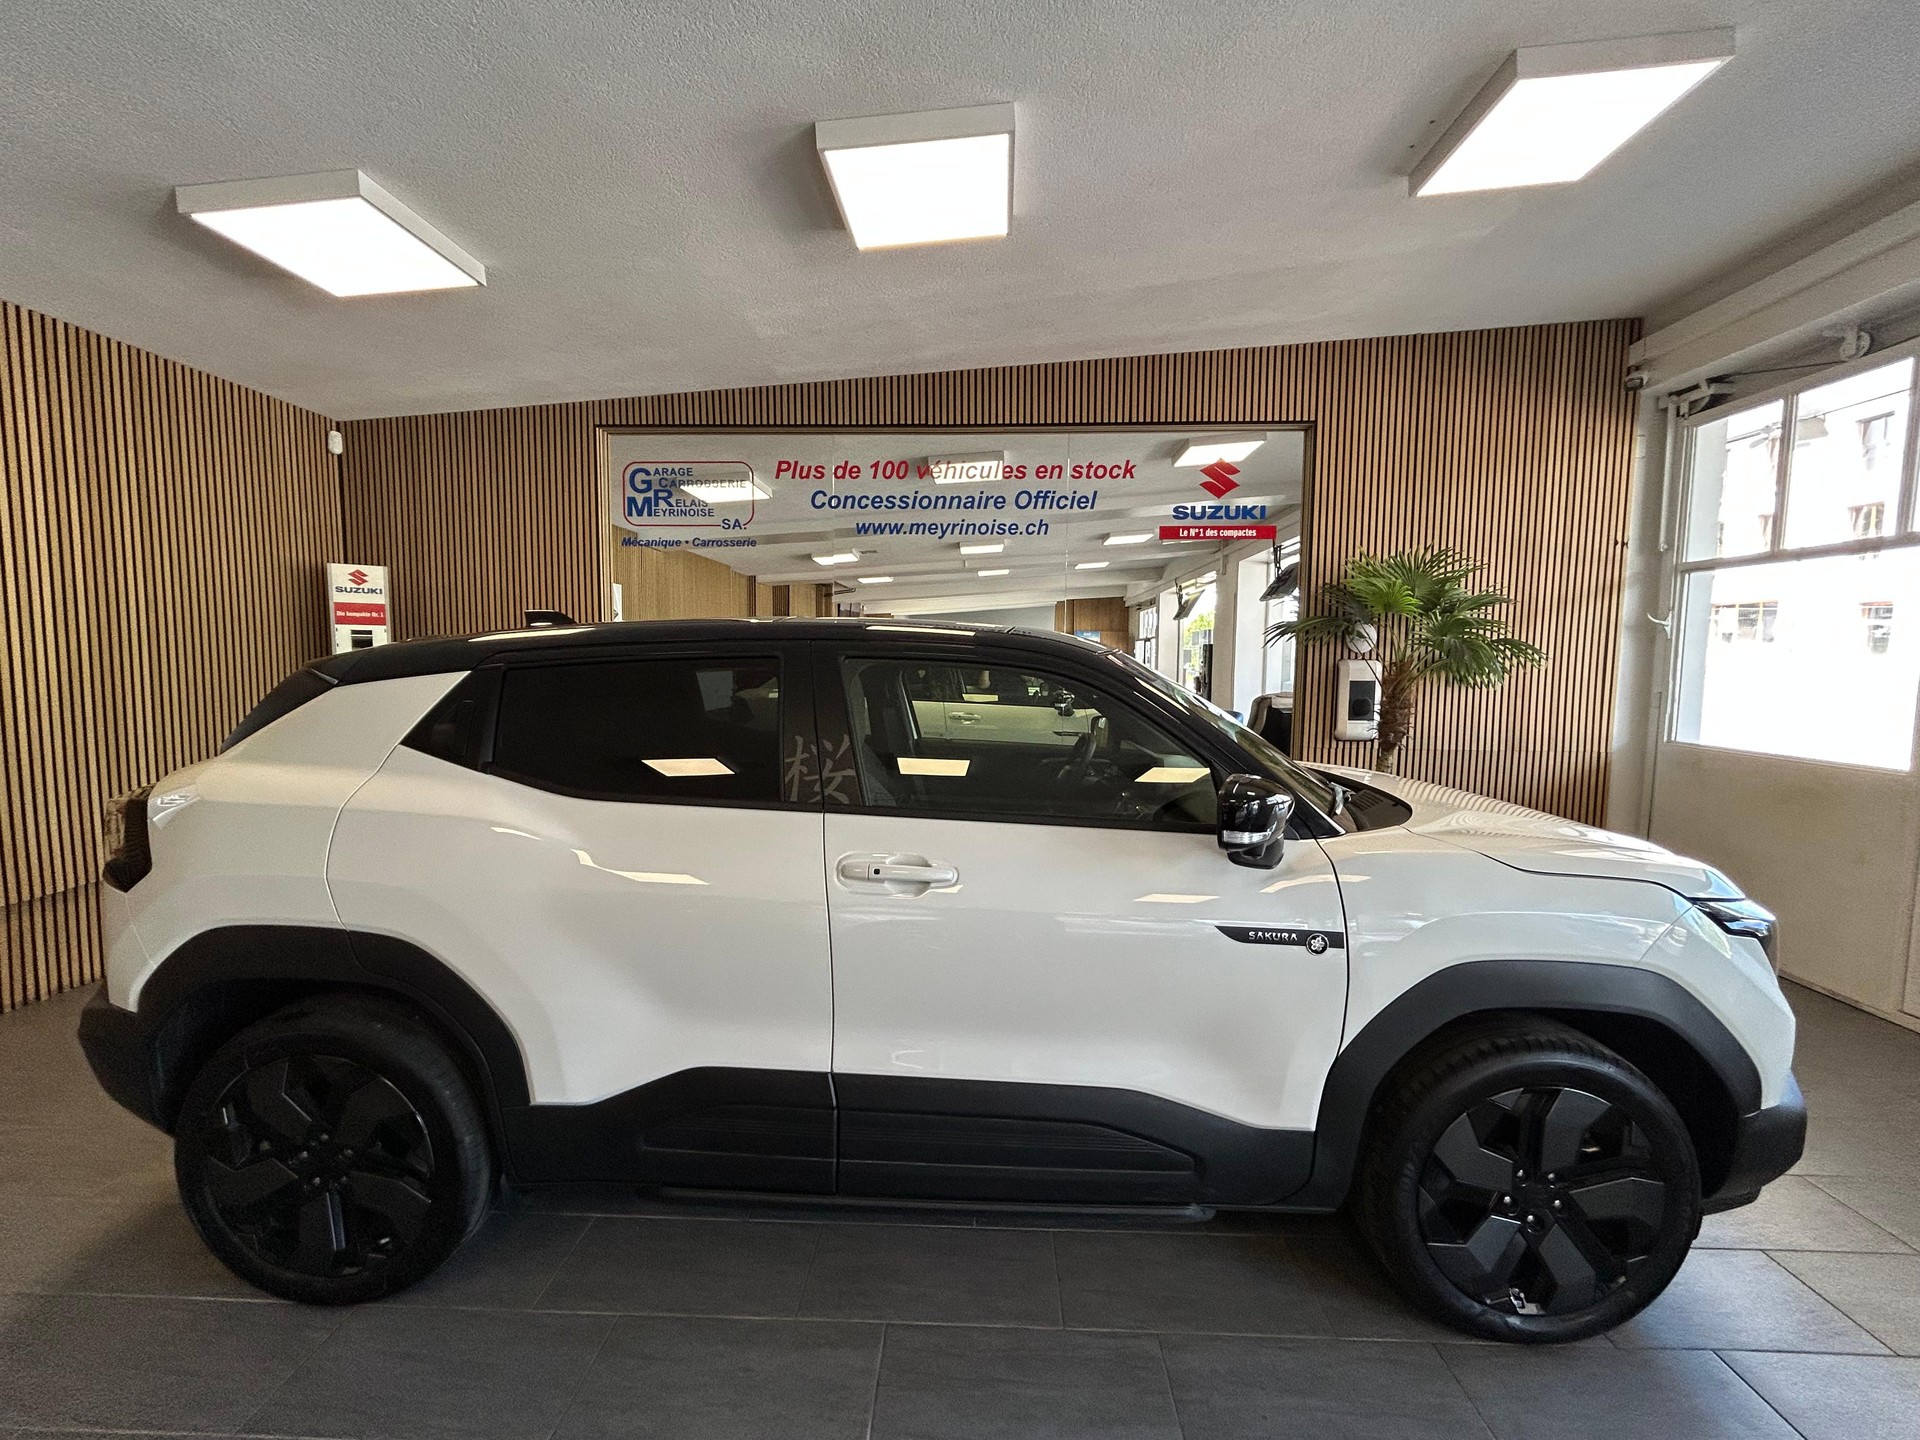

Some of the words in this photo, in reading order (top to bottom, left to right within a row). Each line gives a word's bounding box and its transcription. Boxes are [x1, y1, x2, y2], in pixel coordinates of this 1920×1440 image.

[775, 460, 826, 480] Plus
[833, 460, 861, 480] de
[869, 460, 909, 480] 100
[917, 459, 1027, 480] véhicules
[1035, 464, 1063, 479] en
[1070, 460, 1137, 480] stock
[811, 490, 1006, 510] Concessionnaire
[1014, 490, 1098, 510] Officiel
[1172, 505, 1267, 520] SUZUKI
[855, 519, 1049, 540] www.meyrinoise.ch
[1179, 528, 1188, 537] Le
[1205, 528, 1218, 537] des
[1219, 528, 1257, 538] compactes
[621, 537, 682, 549] Mécanique
[692, 537, 757, 547] Carrosserie
[335, 586, 383, 594] SUZUKI
[1248, 931, 1298, 941] SAKURA
